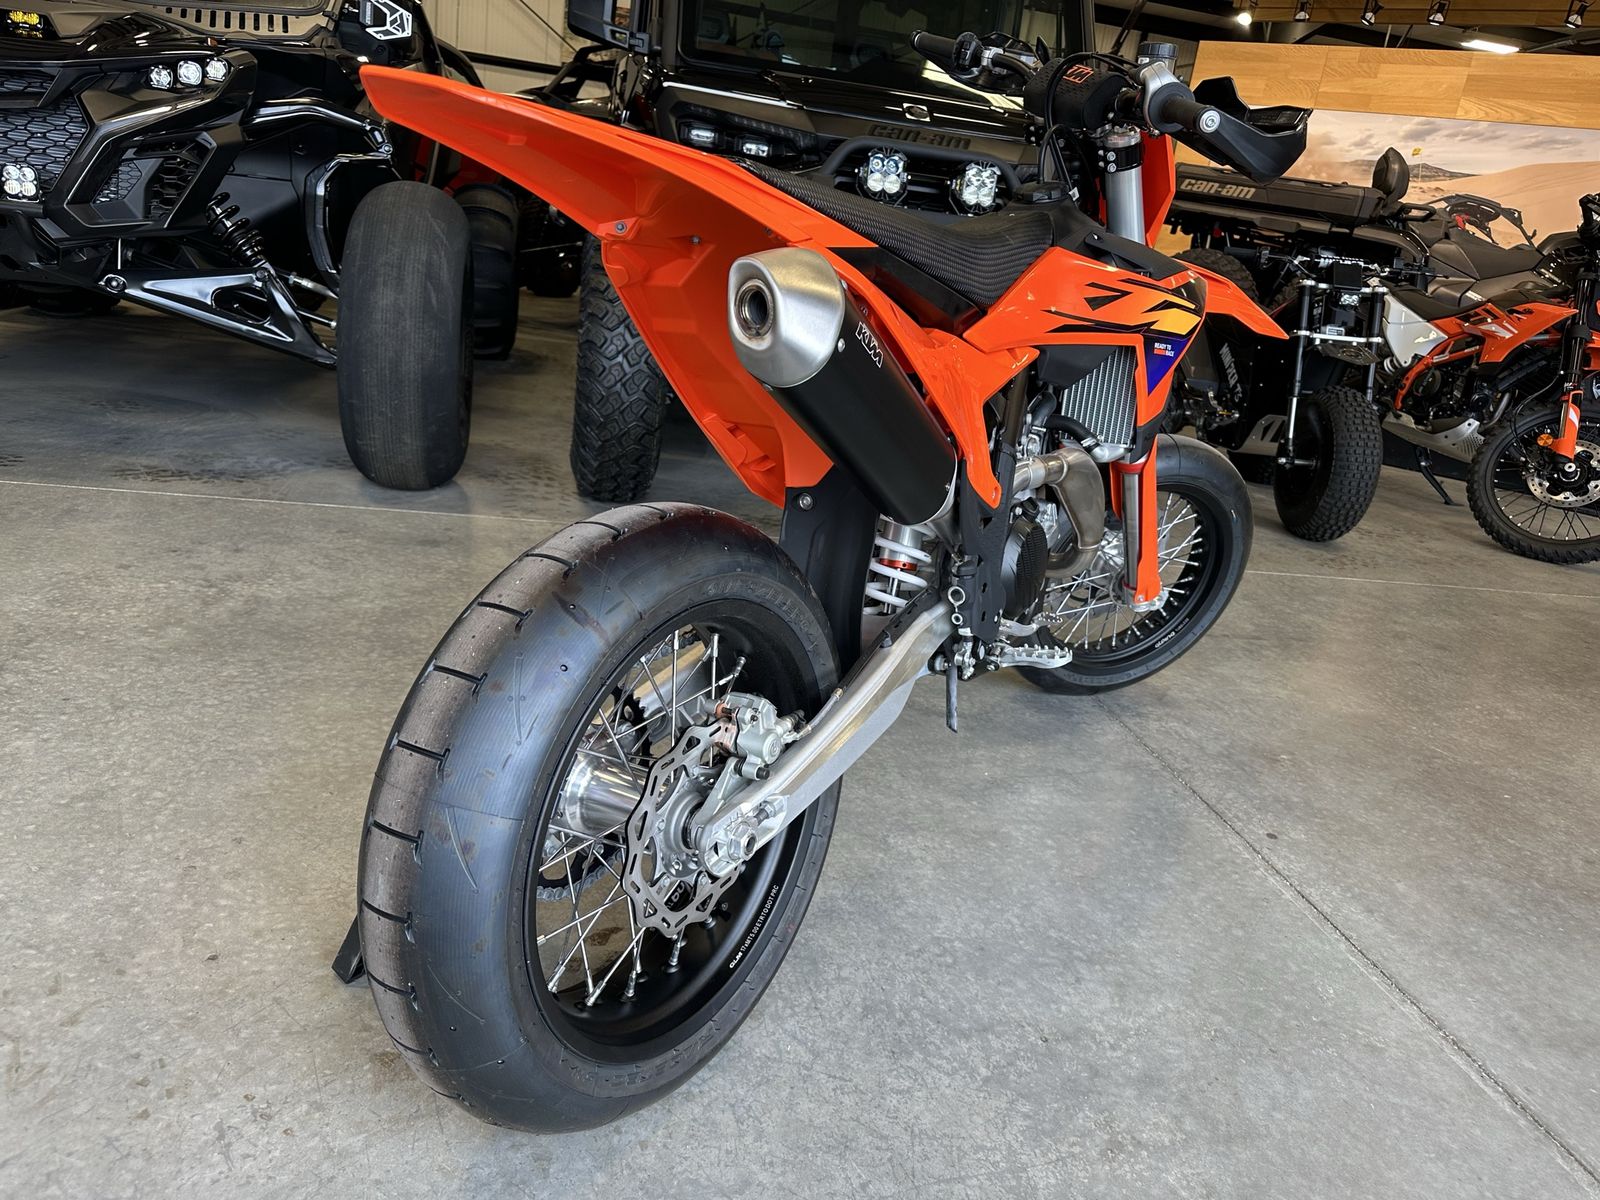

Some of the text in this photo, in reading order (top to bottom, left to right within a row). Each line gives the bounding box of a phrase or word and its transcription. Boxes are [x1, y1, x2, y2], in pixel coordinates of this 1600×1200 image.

[868, 124, 971, 150] can-am
[1180, 179, 1256, 199] can-am
[855, 321, 883, 368] KTM
